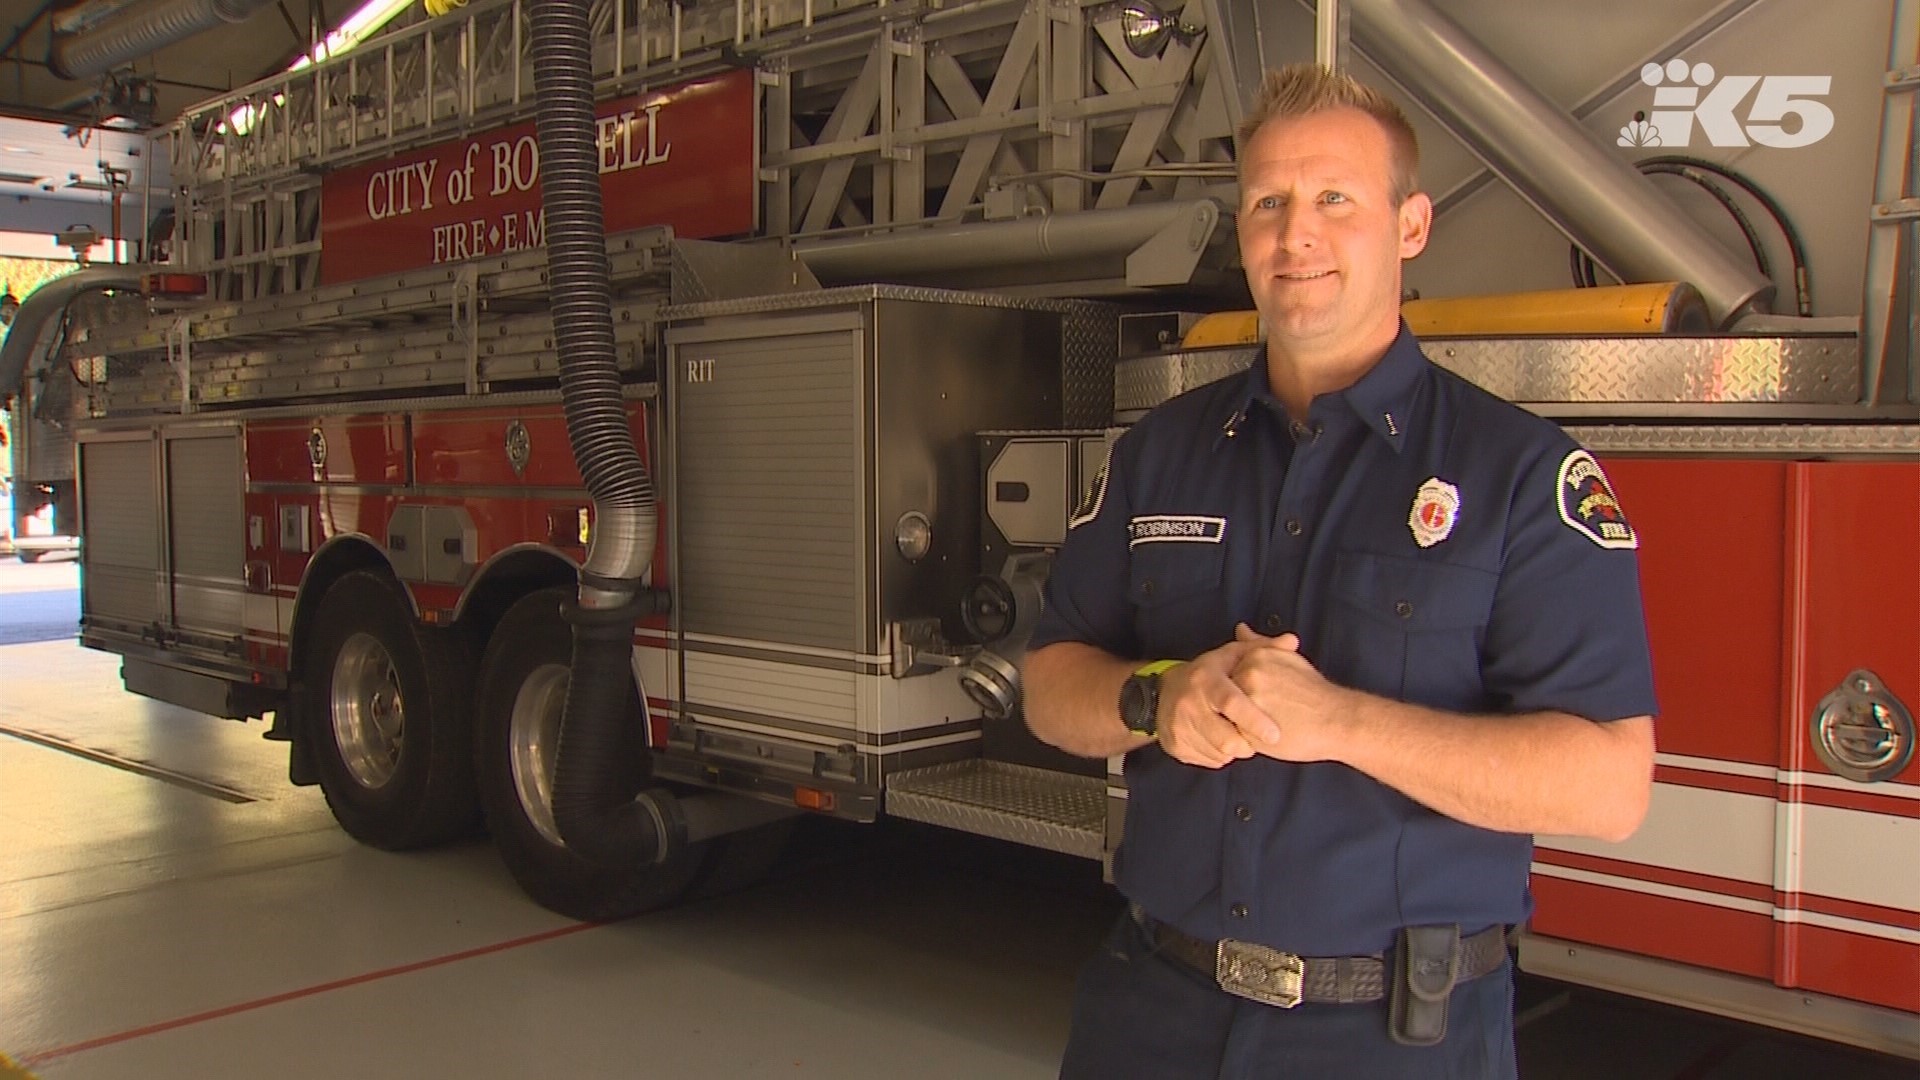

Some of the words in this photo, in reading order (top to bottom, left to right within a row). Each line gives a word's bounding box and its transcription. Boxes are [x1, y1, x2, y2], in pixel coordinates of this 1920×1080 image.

[367, 158, 438, 221] CITY
[447, 142, 481, 205] of
[490, 105, 671, 197] BOELL
[432, 219, 486, 264] FIRE
[502, 207, 547, 252] E.M
[688, 358, 716, 382] RIT
[1135, 520, 1205, 538] ROBINSON
